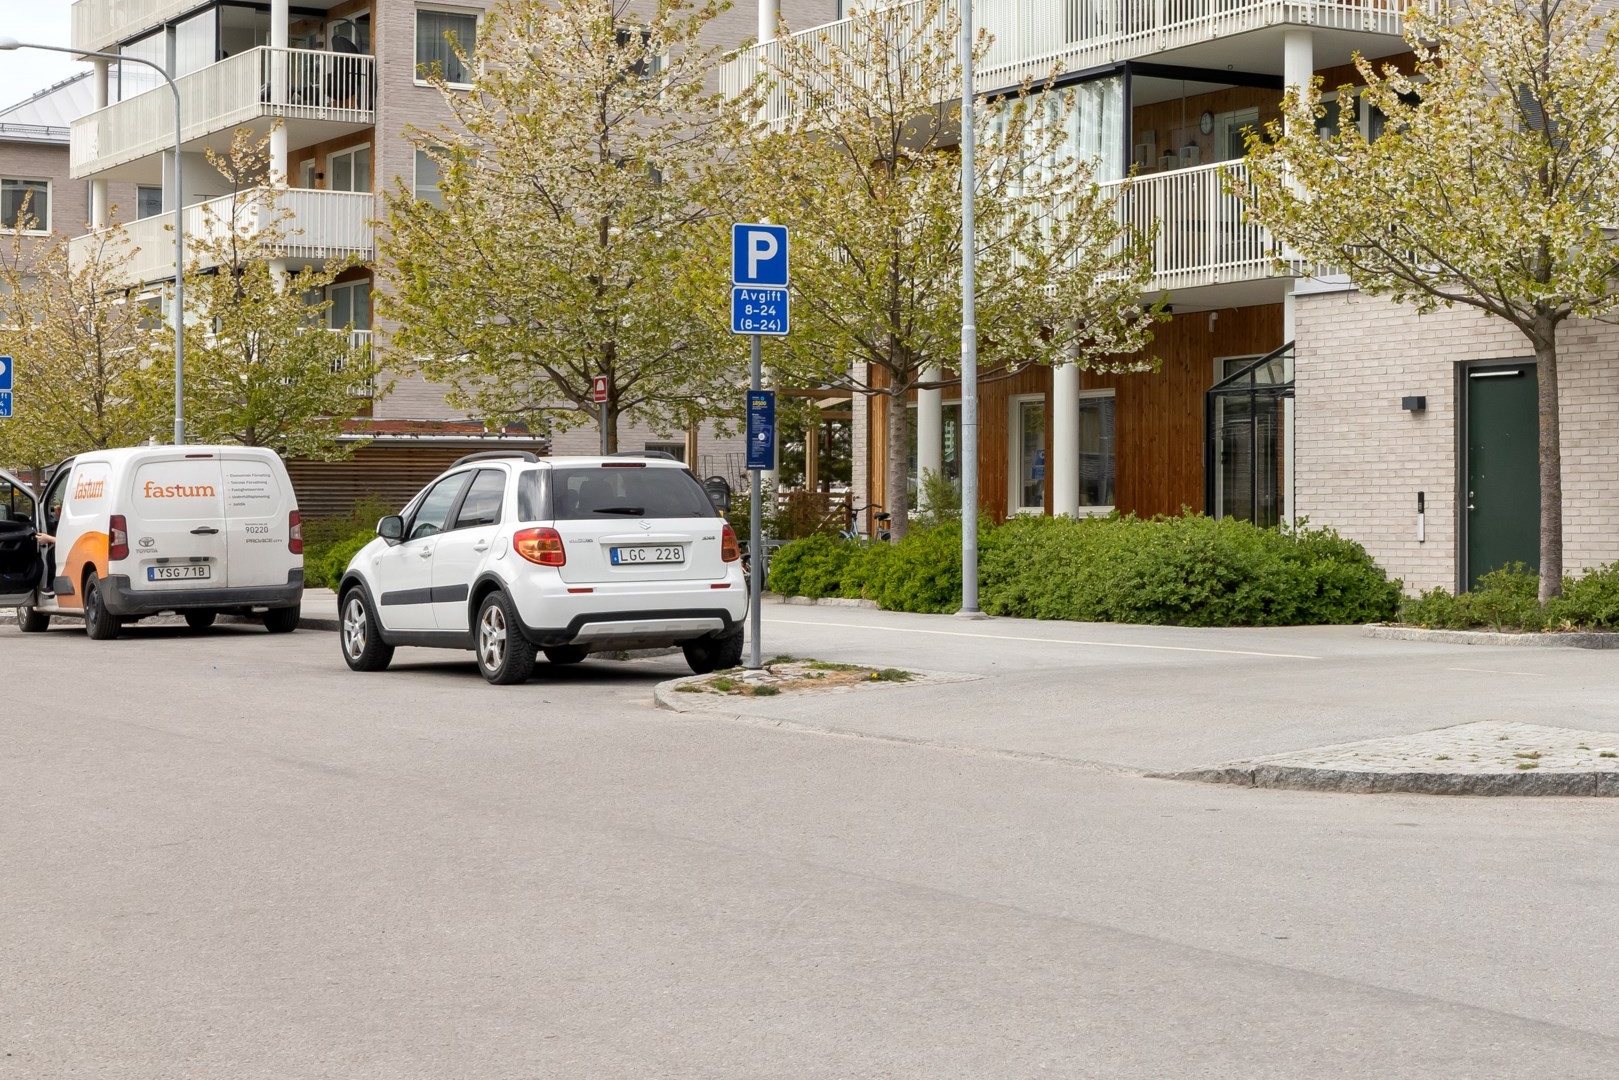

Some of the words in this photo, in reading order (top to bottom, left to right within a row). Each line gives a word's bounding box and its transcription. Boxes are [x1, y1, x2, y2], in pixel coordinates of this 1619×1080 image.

[748, 231, 778, 278] P
[741, 290, 781, 303] Avgift
[745, 304, 776, 316] 8-24
[740, 318, 781, 331] (8-24)
[144, 481, 215, 498] fastum
[245, 526, 269, 534] 90220
[619, 549, 646, 562] LGC
[655, 547, 681, 561] 228
[158, 567, 180, 578] YSG
[183, 566, 205, 577] 71B
